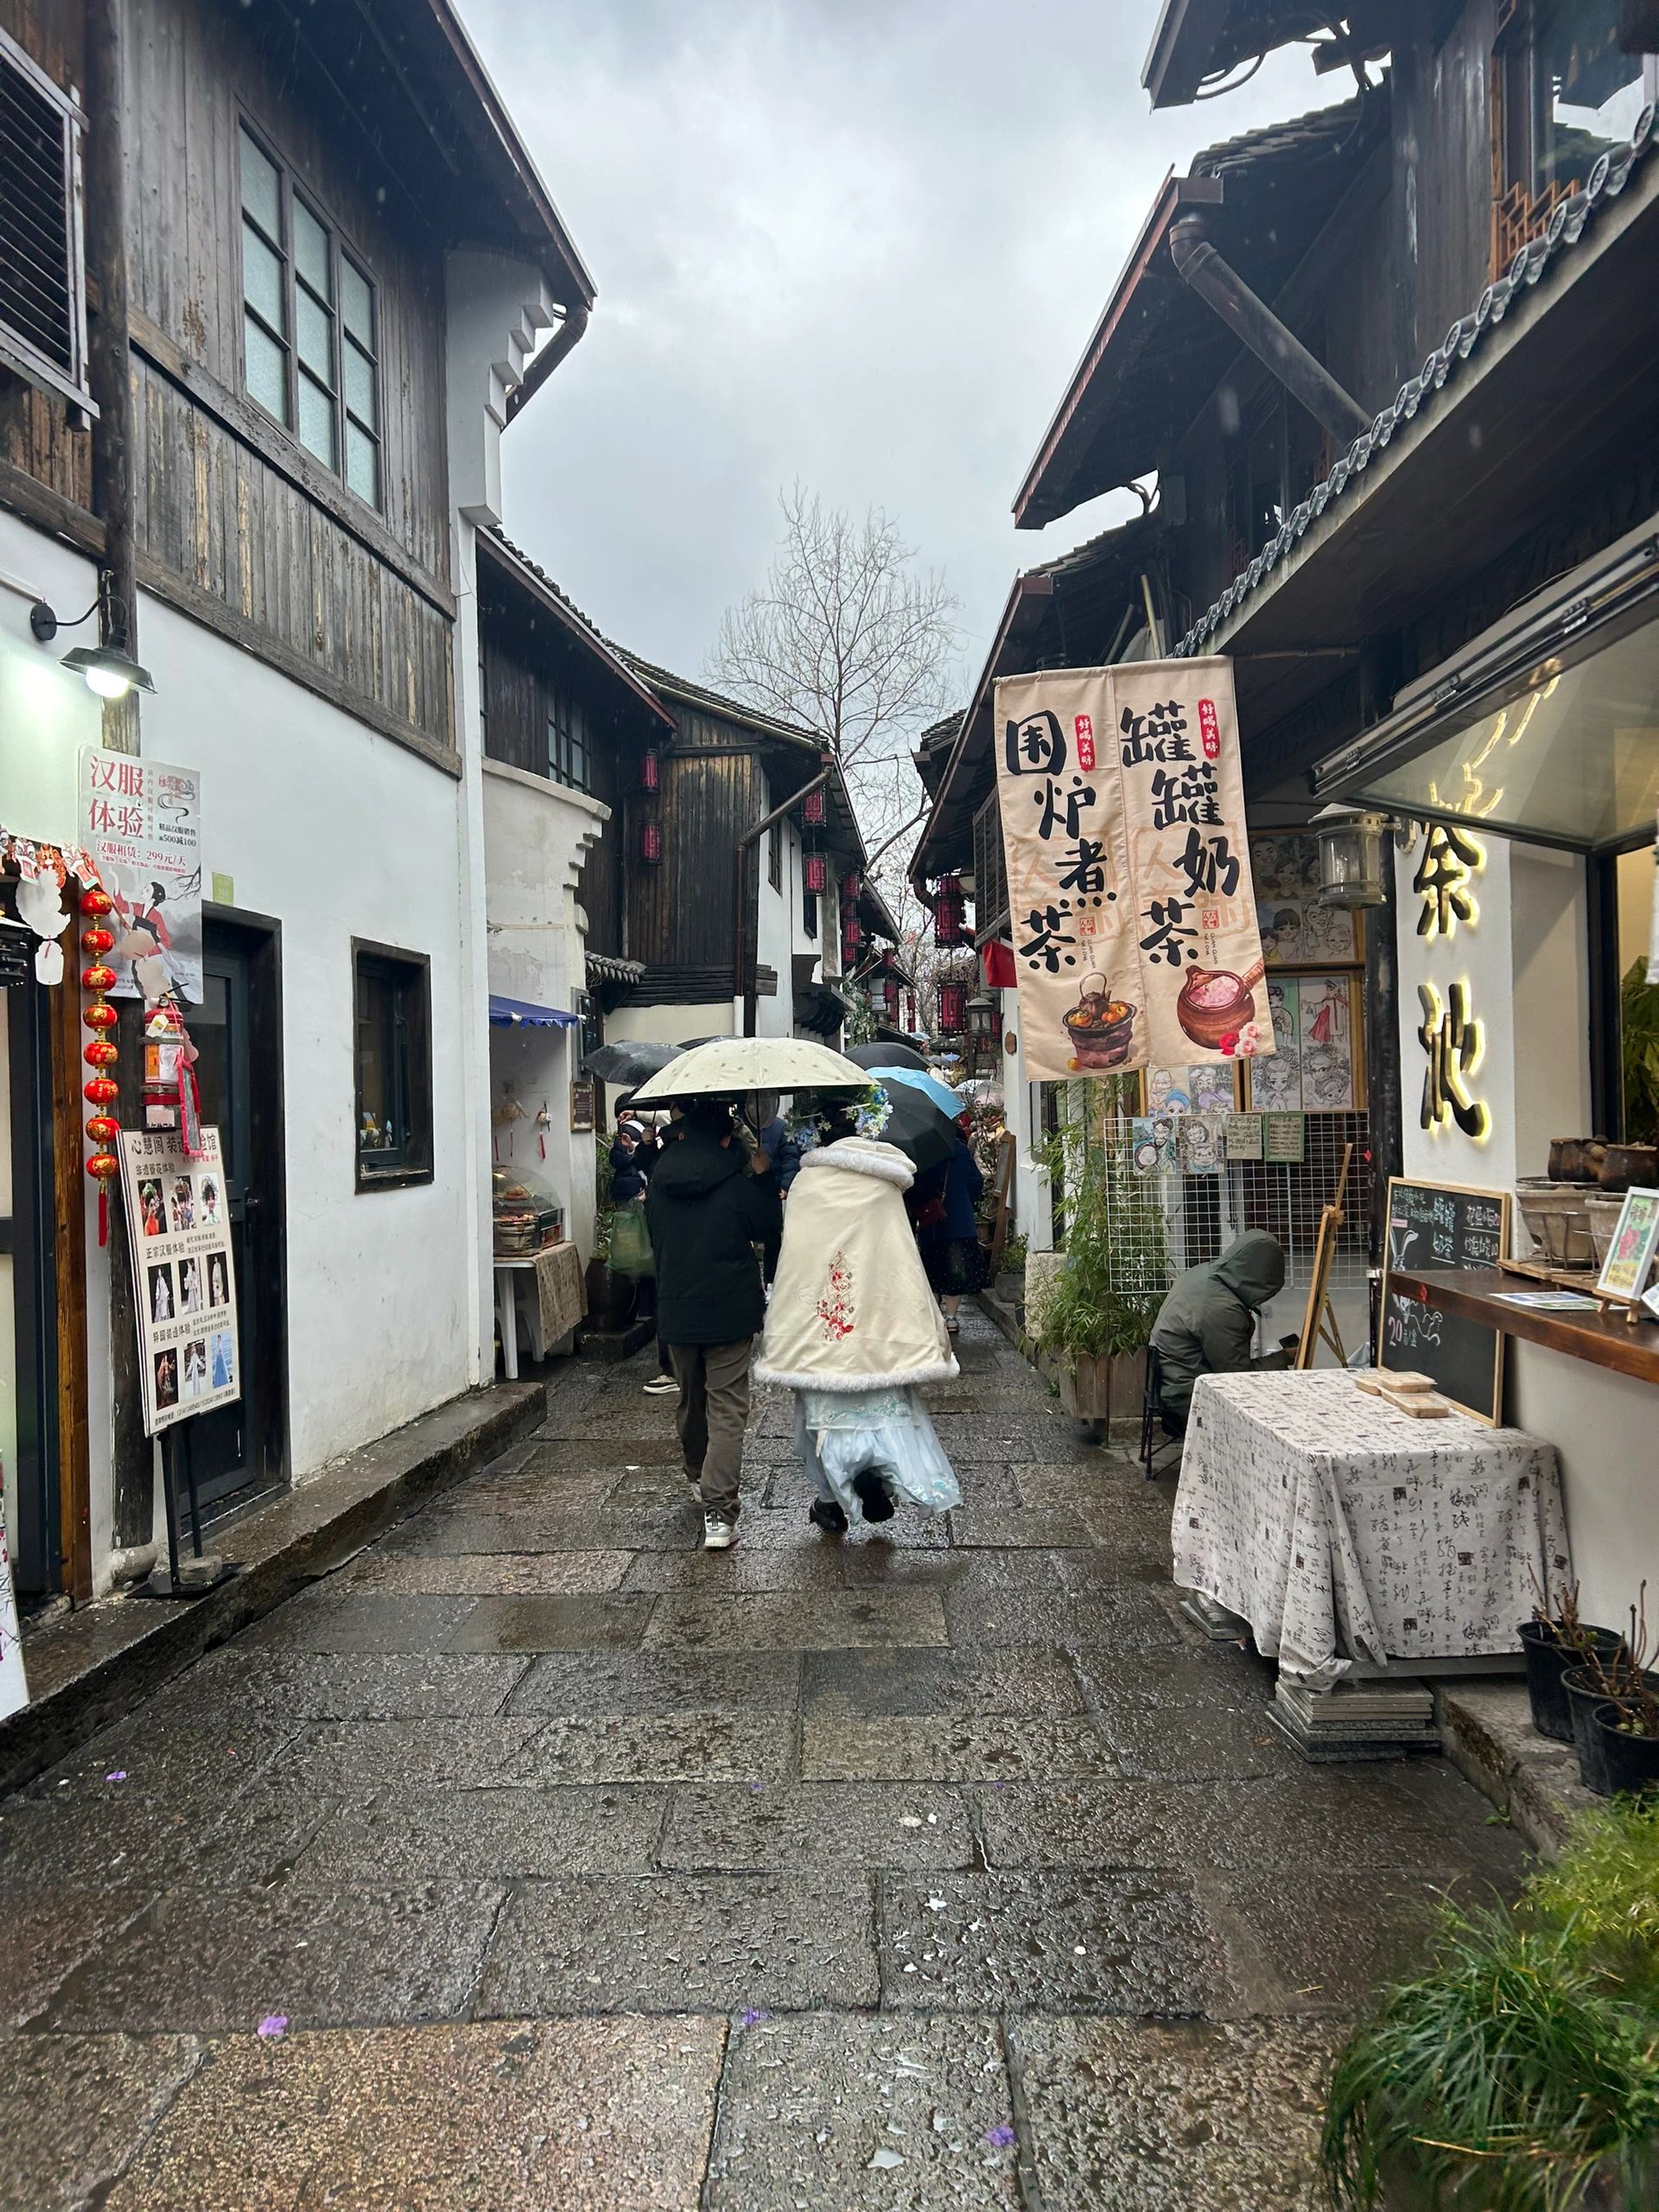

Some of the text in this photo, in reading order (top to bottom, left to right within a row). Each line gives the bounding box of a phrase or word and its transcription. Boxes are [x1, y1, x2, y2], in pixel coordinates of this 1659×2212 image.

[1077, 717, 1094, 767] 好喝美味
[1200, 702, 1217, 754] 好喝美味
[89, 754, 143, 798] 汉服
[88, 798, 143, 839] 体验
[1006, 709, 1117, 974] 围炉煮茶
[1121, 701, 1240, 968] 罐罐奶茶
[130, 1135, 164, 1155] 心慧阁
[145, 1241, 185, 1259] 正宗汉服体验
